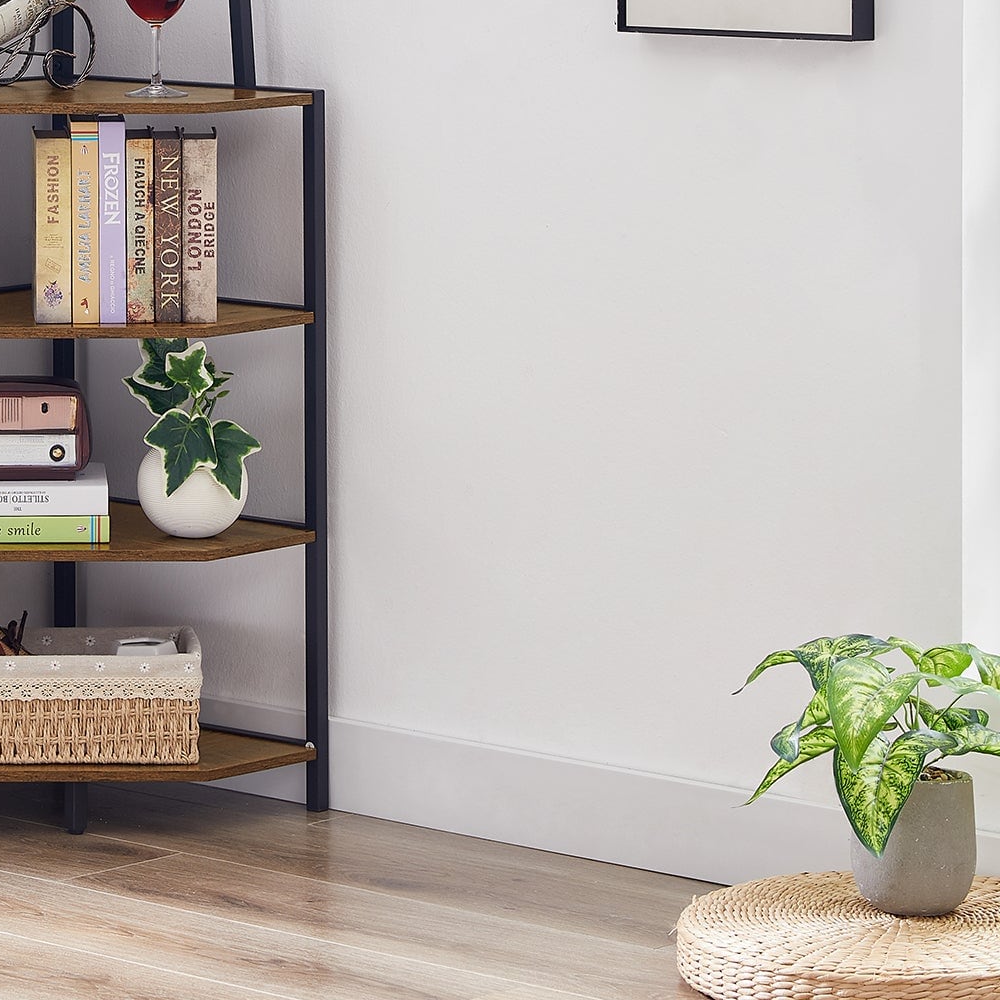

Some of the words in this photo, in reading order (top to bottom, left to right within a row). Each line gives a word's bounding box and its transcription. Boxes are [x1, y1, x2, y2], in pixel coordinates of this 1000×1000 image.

[47, 155, 60, 225] FASHION
[102, 152, 121, 225] FROZEN
[134, 212, 146, 221] A
[160, 155, 180, 217] NEW
[187, 189, 202, 271] LONDON
[204, 202, 215, 258] BRIDGE
[160, 235, 180, 308] YORK
[7, 522, 41, 536] smile
[12, 495, 50, 503] STILETTO
